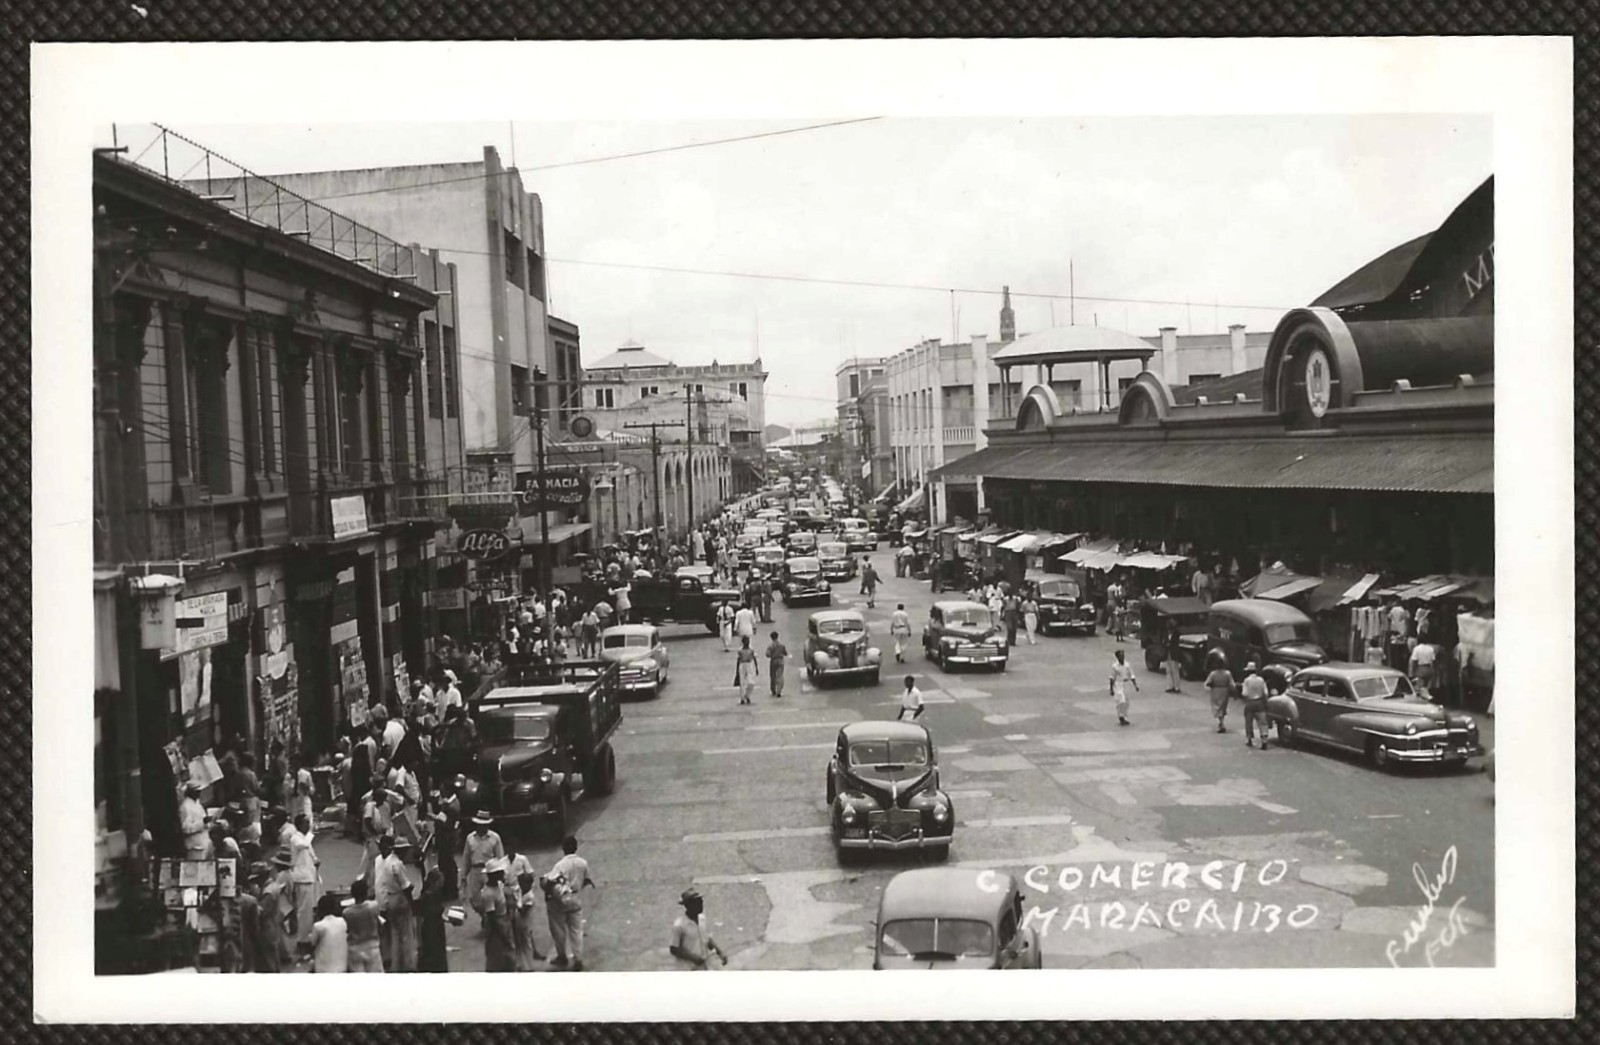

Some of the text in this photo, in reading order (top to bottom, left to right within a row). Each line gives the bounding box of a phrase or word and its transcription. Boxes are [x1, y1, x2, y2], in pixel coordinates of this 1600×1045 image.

[1463, 243, 1494, 299] M
[525, 478, 580, 490] FAMACIA
[461, 533, 504, 559] Alfa
